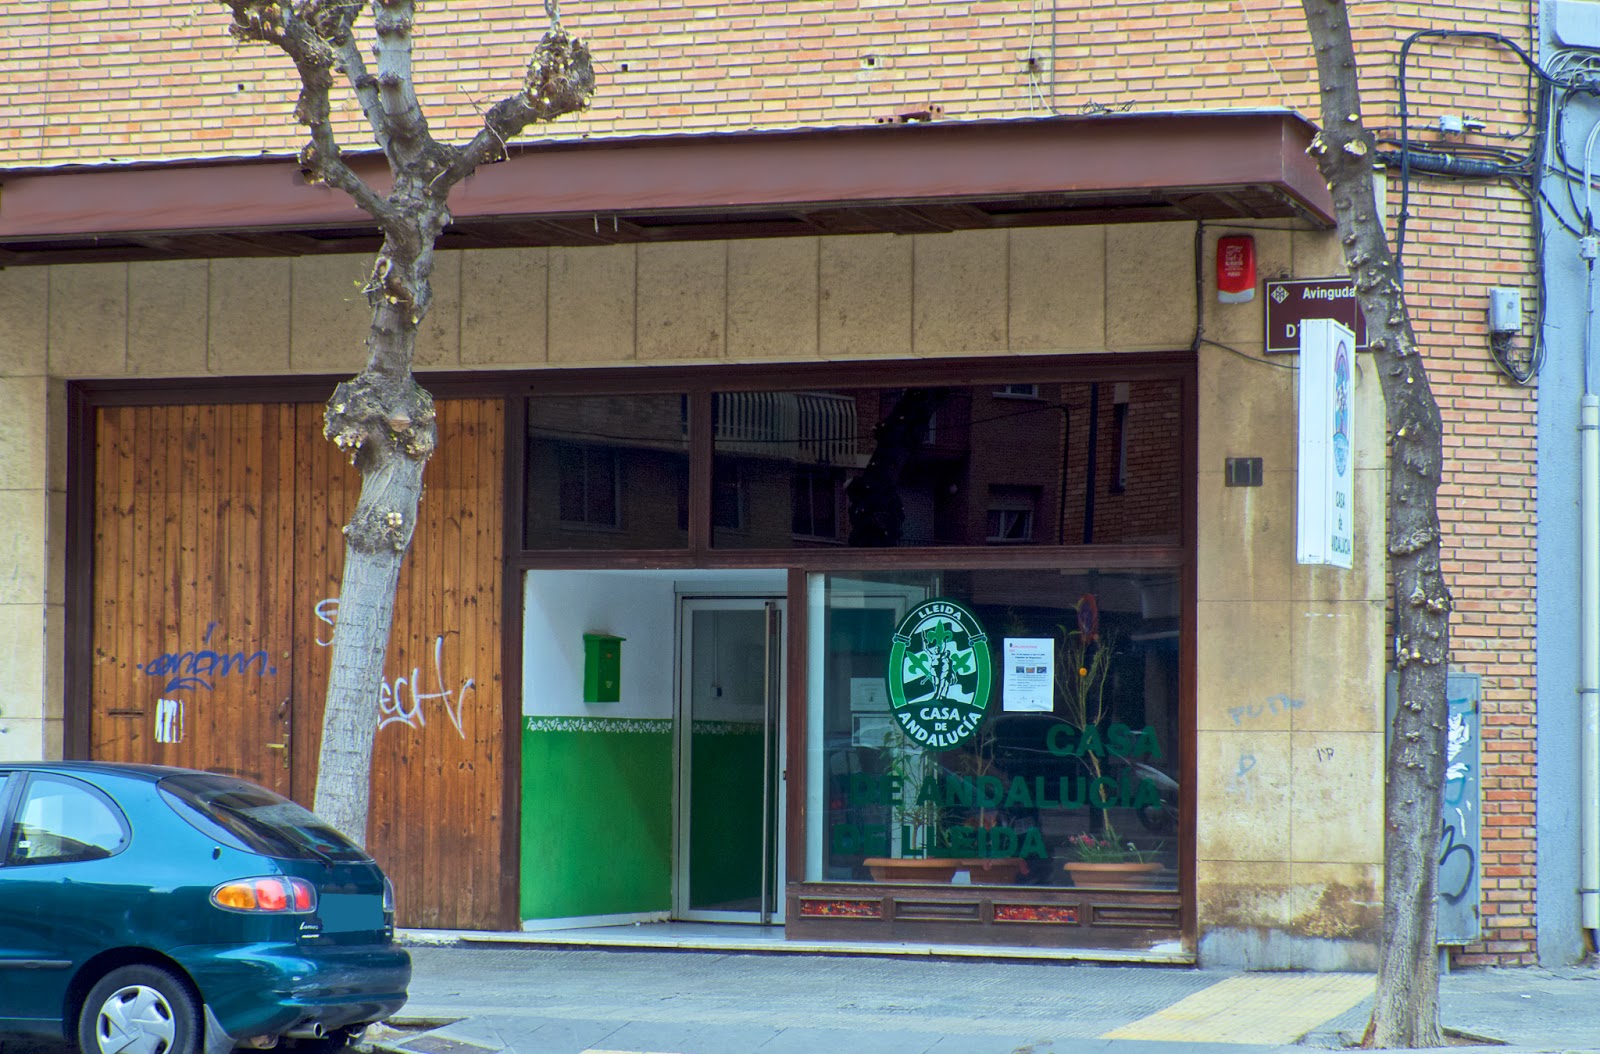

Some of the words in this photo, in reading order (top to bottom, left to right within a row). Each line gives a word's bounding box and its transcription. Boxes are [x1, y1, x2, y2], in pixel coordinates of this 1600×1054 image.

[1303, 286, 1357, 301] Avinguda
[1229, 459, 1253, 485] 11
[918, 604, 963, 620] LLEIDA
[920, 707, 961, 721] CASA
[934, 722, 948, 731] DE
[898, 711, 982, 747] ANDALUCÍA
[1046, 723, 1162, 759] CASA
[851, 775, 901, 806] DE
[917, 767, 1162, 809] ANDALUCÍA
[833, 824, 887, 855] DE
[901, 825, 1048, 859] LLEIDA
